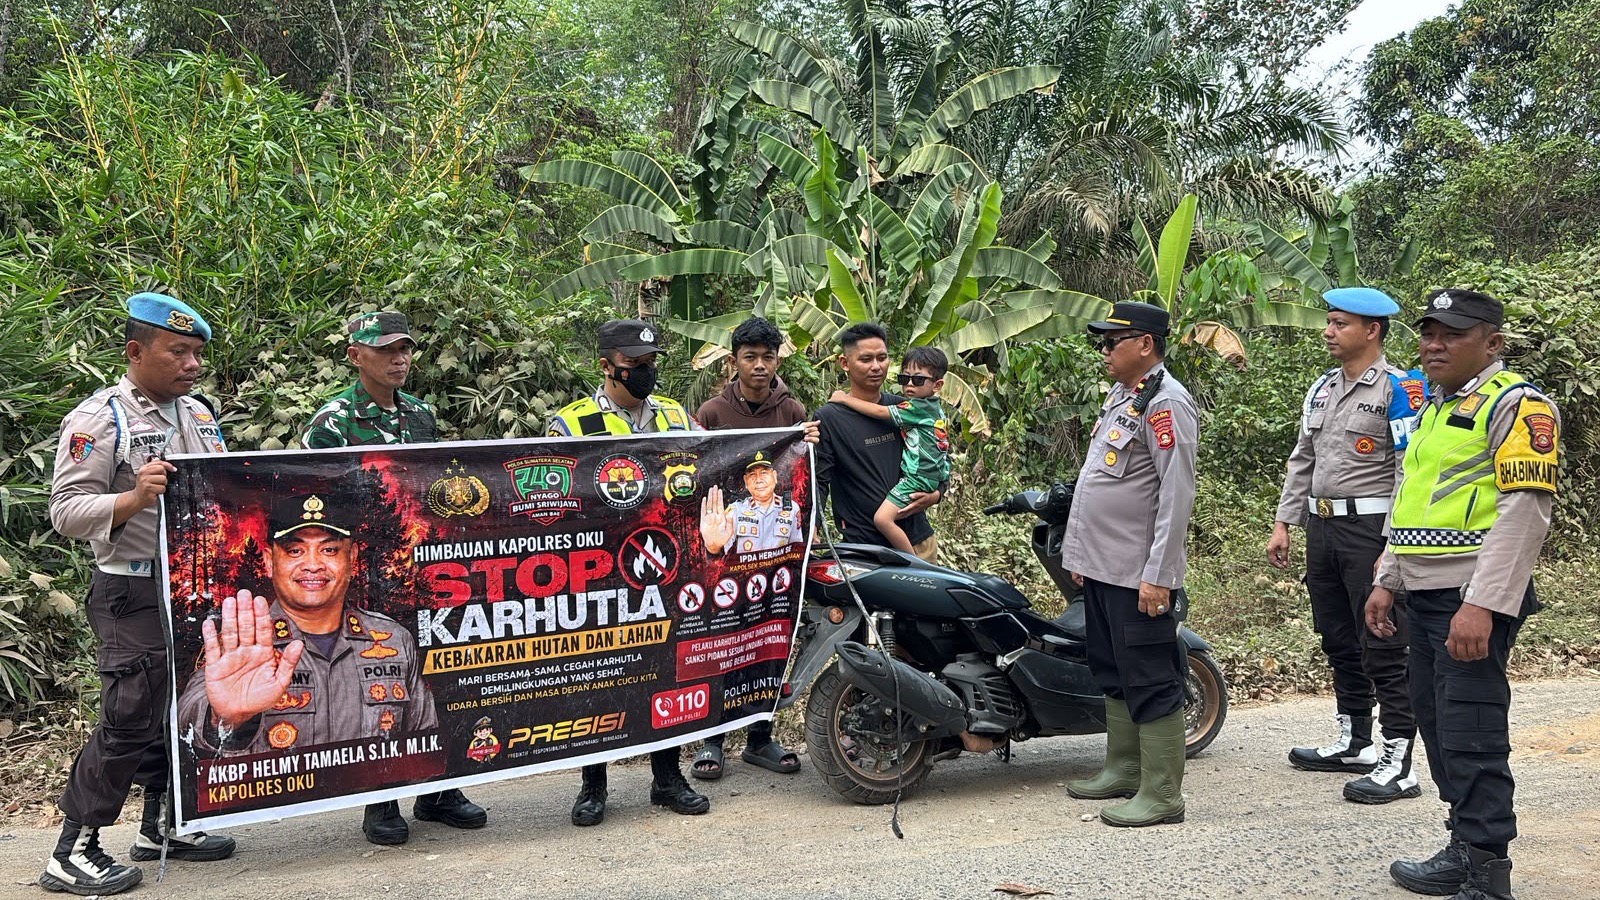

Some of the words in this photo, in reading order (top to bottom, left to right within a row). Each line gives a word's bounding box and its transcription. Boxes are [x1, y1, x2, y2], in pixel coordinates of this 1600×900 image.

[1357, 402, 1386, 416] POLRI
[1115, 414, 1140, 432] POLRI
[507, 461, 524, 469] POLDA
[530, 492, 560, 501] NYAGO
[512, 502, 535, 513] BUMI
[537, 500, 578, 508] SRIWIJAYA
[775, 517, 793, 526] POLRI
[414, 540, 494, 563] HIMBAUAN
[498, 533, 573, 555] KAPOLRES
[576, 530, 604, 547] OKU
[740, 553, 757, 563] IPDA
[758, 547, 785, 560] HERMAN
[730, 563, 759, 572] KAPOLSEK
[417, 549, 614, 609] STOP
[891, 574, 935, 584] NMAX
[417, 584, 667, 647] KARHUTLA
[683, 614, 701, 622] JANGAN
[717, 609, 735, 617] JANGAN
[680, 621, 704, 629] MEMBAKAR
[432, 645, 526, 671] KEBAKARAN
[532, 636, 581, 658] HUTAN
[586, 631, 614, 651] DAN
[619, 624, 663, 646] LAHAN
[691, 643, 713, 653] PELAKU
[713, 635, 741, 648] KARHUTLA
[741, 630, 755, 641] DAPAT
[685, 655, 707, 665] SANKSI
[707, 650, 728, 661] PIDANA
[728, 645, 744, 656] SESUAI
[720, 659, 733, 670] YANG
[734, 652, 757, 666] BERLAKU
[363, 664, 402, 679] POLRI
[458, 675, 483, 687] MARI
[485, 664, 561, 684] BERSAMA-SAMA
[563, 660, 595, 673] CEGAH
[596, 652, 643, 667] KARHUTLA
[506, 675, 568, 693] LINGKUNGAN
[570, 671, 595, 683] YANG
[596, 667, 626, 680] SEHAT,
[724, 683, 750, 699] POLRI
[753, 677, 780, 690] UNTU
[447, 699, 479, 712] UDARA
[480, 694, 512, 708] BERSIH
[514, 691, 534, 703] DAN
[535, 687, 560, 700] MASA
[561, 683, 591, 695] DEPAN
[591, 680, 615, 691] ANAK
[617, 675, 640, 687] CUCU
[640, 672, 658, 683] KITA
[676, 689, 706, 713] 110
[724, 690, 778, 711] MASYARAK
[660, 715, 683, 726] LAYANAN
[684, 711, 701, 720] POLISI
[507, 711, 627, 749] PRESISI
[532, 742, 568, 755] RESPONSIBILITAS
[207, 764, 248, 785] AKBP
[252, 756, 302, 779] HELMY
[304, 747, 366, 770] TAMAELA
[369, 741, 403, 760] S.I.K,
[406, 734, 443, 755] M.I.K.
[208, 778, 284, 804] KAPOLRES
[287, 773, 315, 793] OKU
